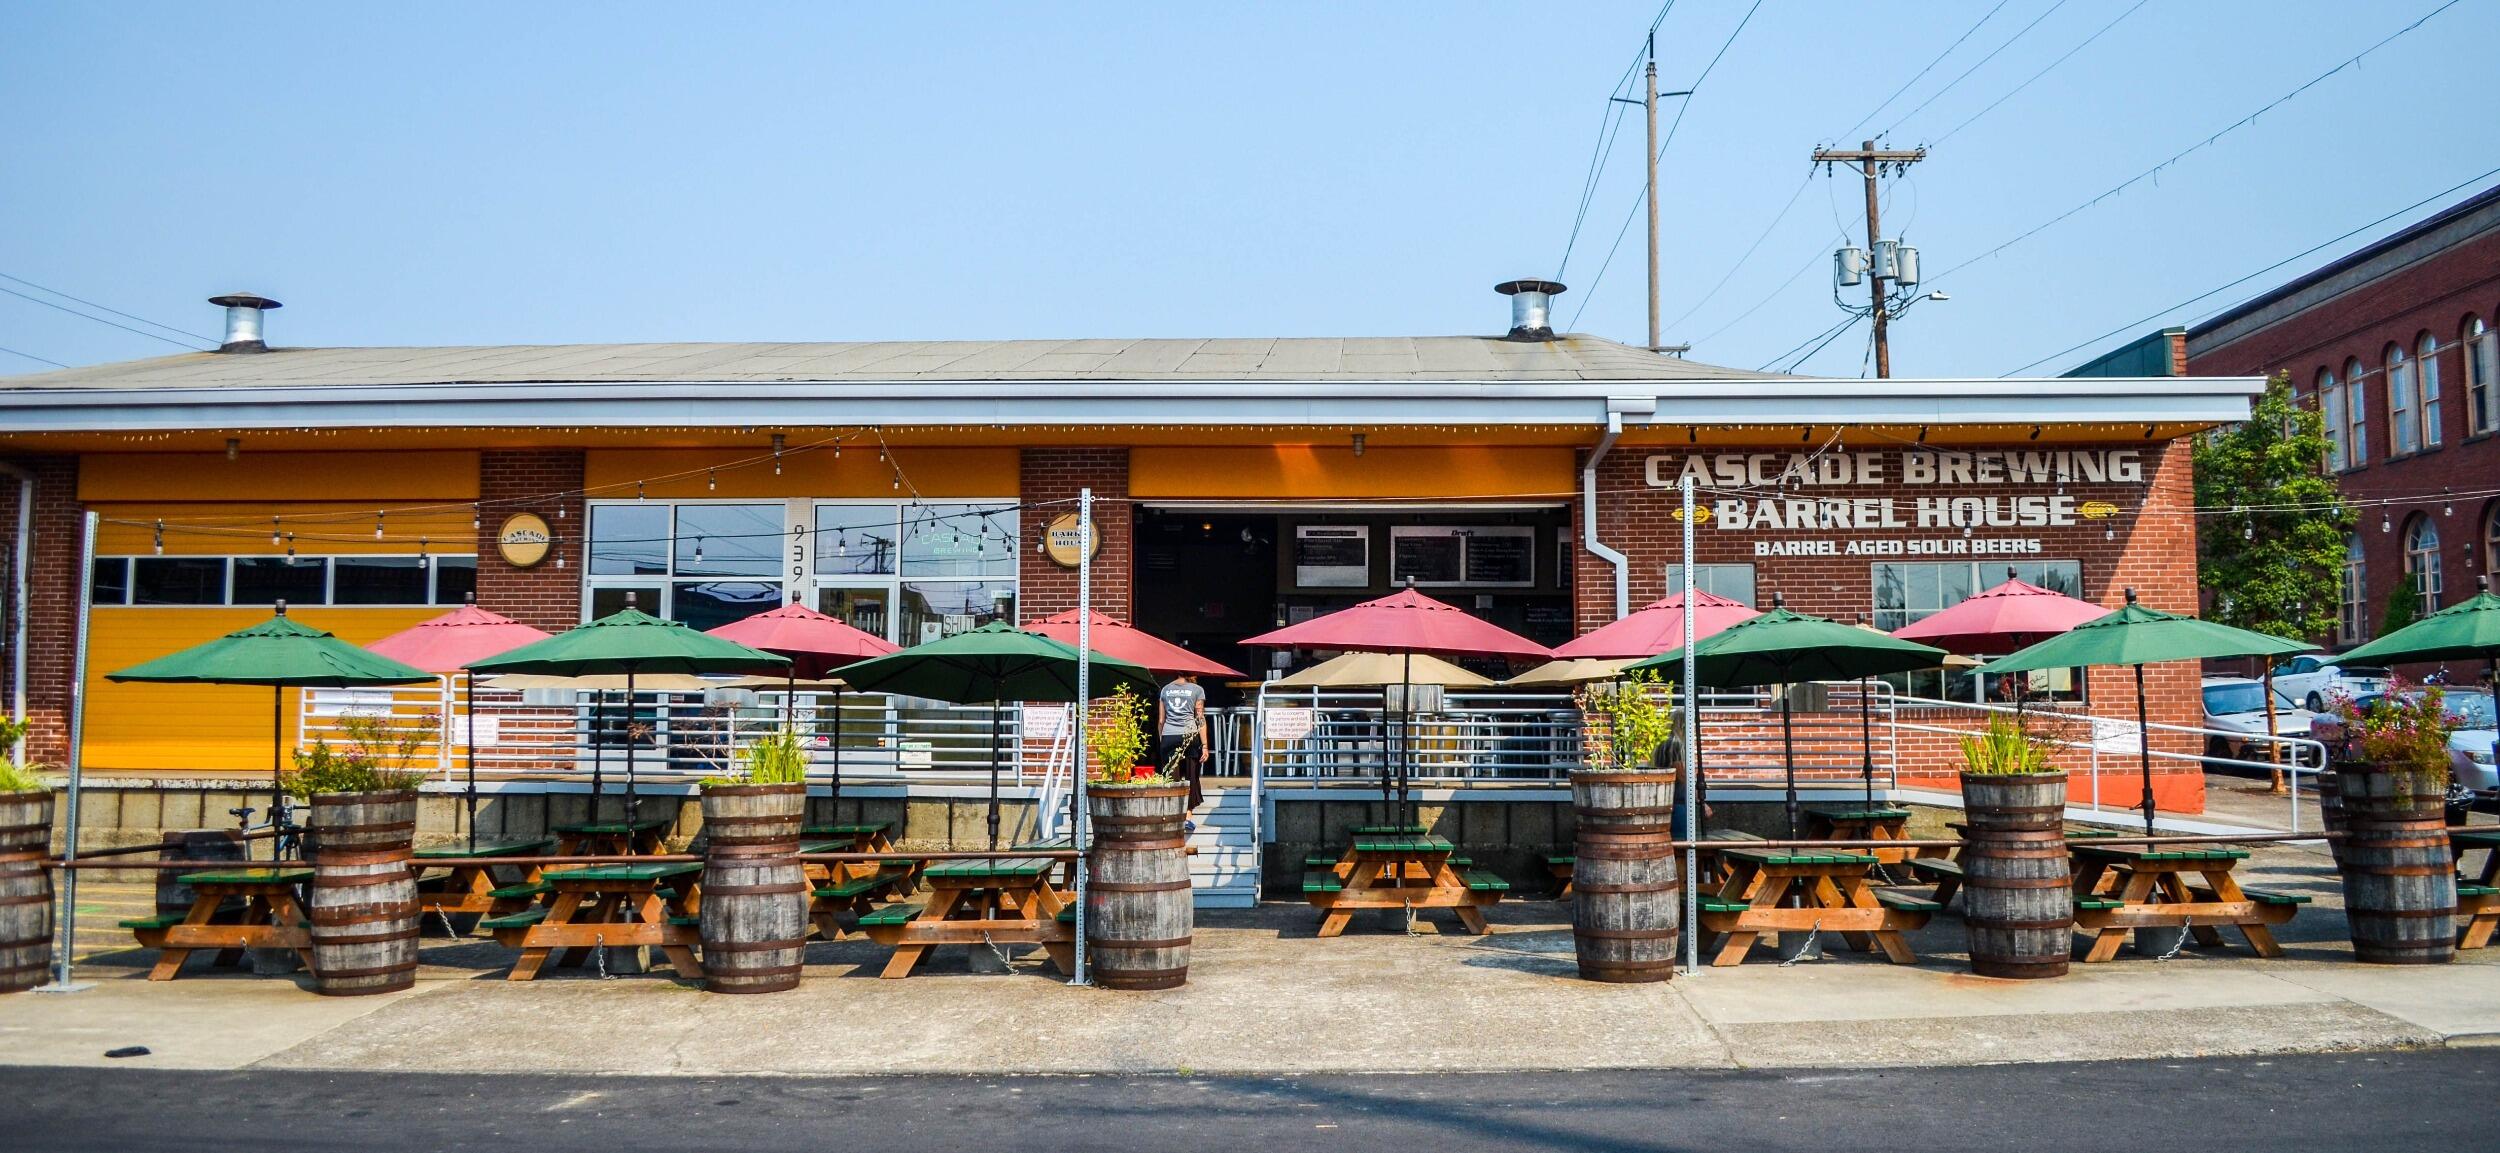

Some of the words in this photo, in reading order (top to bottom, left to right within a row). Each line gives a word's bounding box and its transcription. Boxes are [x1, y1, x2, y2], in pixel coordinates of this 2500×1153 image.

[1645, 452, 1885, 487] CASCADE
[1902, 450, 2142, 484] BREWING
[1717, 498, 1907, 530] BARREL
[1916, 495, 2076, 528] HOUSE
[1754, 540, 1841, 556] BARREL
[1844, 540, 1903, 555] AGED
[1907, 539, 1970, 555] SOUR
[1971, 538, 2042, 554] BEERS
[944, 615, 975, 634] SHUT
